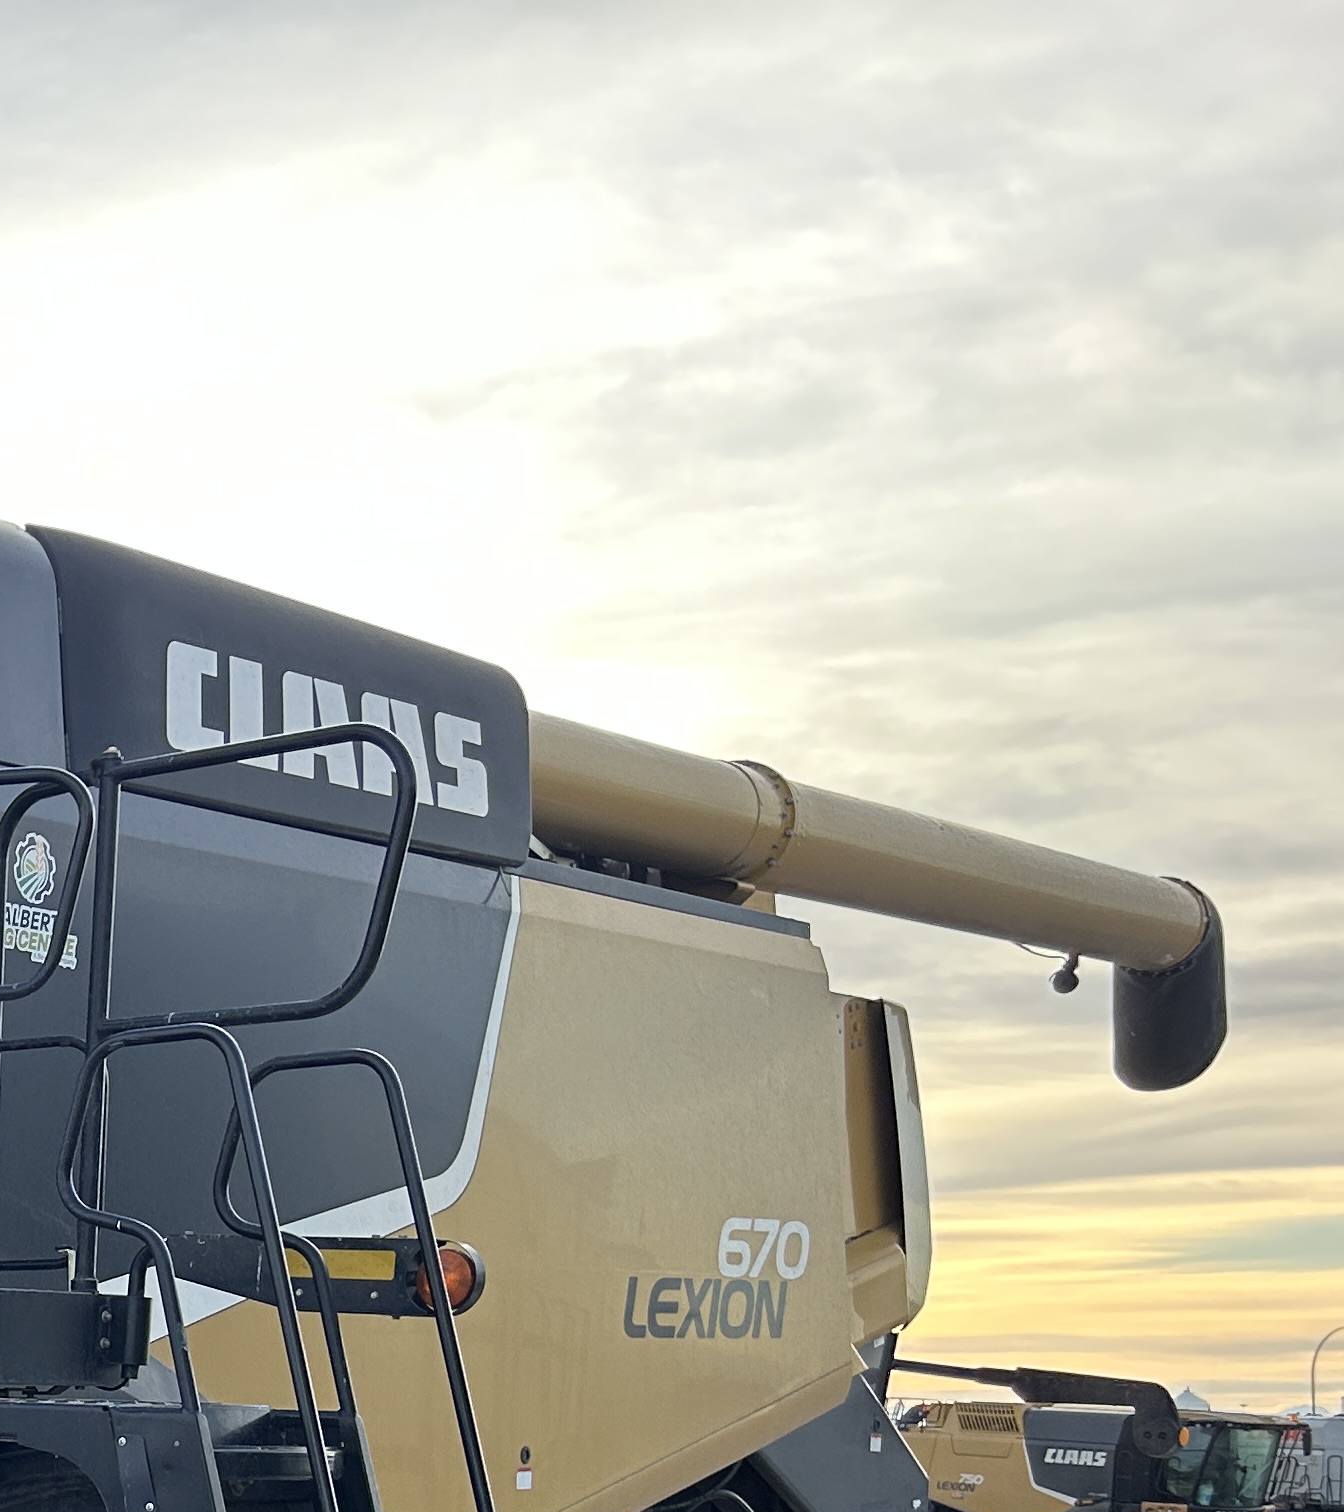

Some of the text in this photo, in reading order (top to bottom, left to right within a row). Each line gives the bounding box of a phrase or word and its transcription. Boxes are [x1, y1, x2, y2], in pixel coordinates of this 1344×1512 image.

[166, 640, 489, 818] CLAAS
[5, 907, 57, 932] ALBER
[18, 930, 75, 956] CENE
[718, 1217, 810, 1280] 670
[624, 1276, 788, 1339] LEXION
[1043, 1448, 1108, 1468] CLAAS
[936, 1480, 977, 1493] LEXION
[958, 1473, 985, 1486] 750
